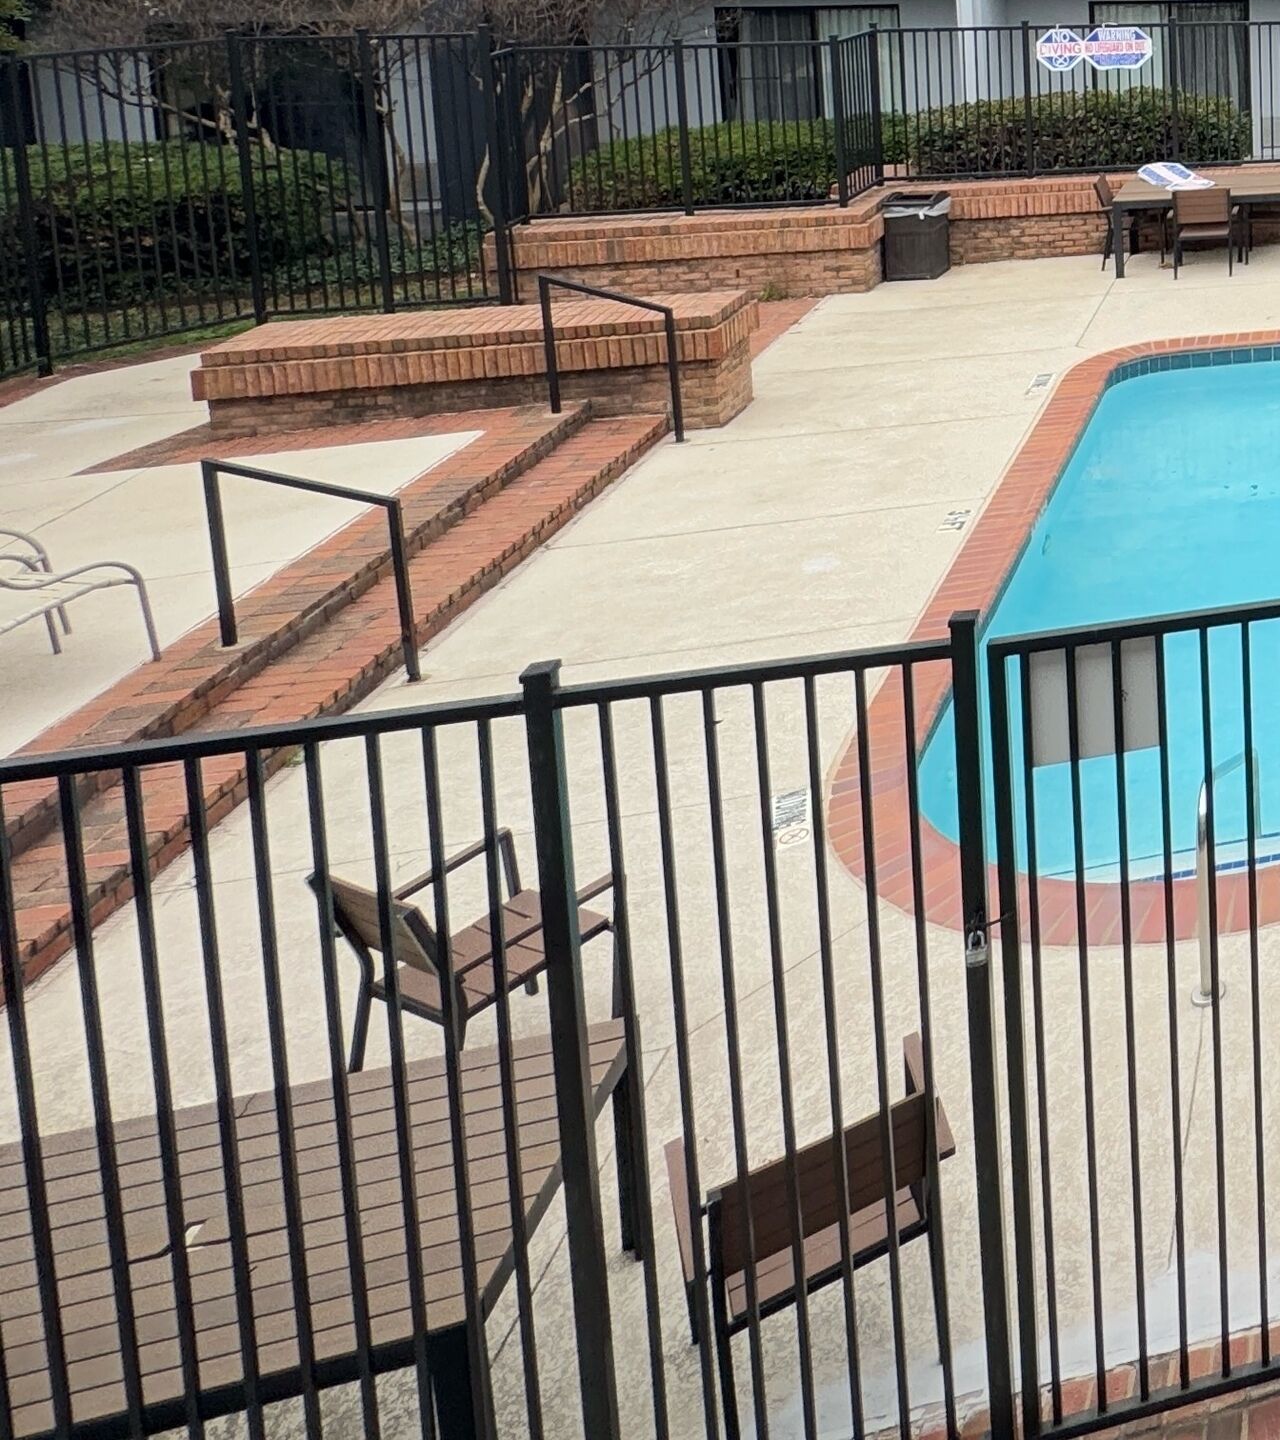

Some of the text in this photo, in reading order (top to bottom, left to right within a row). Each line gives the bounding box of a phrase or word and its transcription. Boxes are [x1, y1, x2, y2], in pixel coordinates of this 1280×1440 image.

[1051, 31, 1070, 43] NO
[1098, 30, 1136, 41] WARNING
[1040, 43, 1082, 56] DIVING
